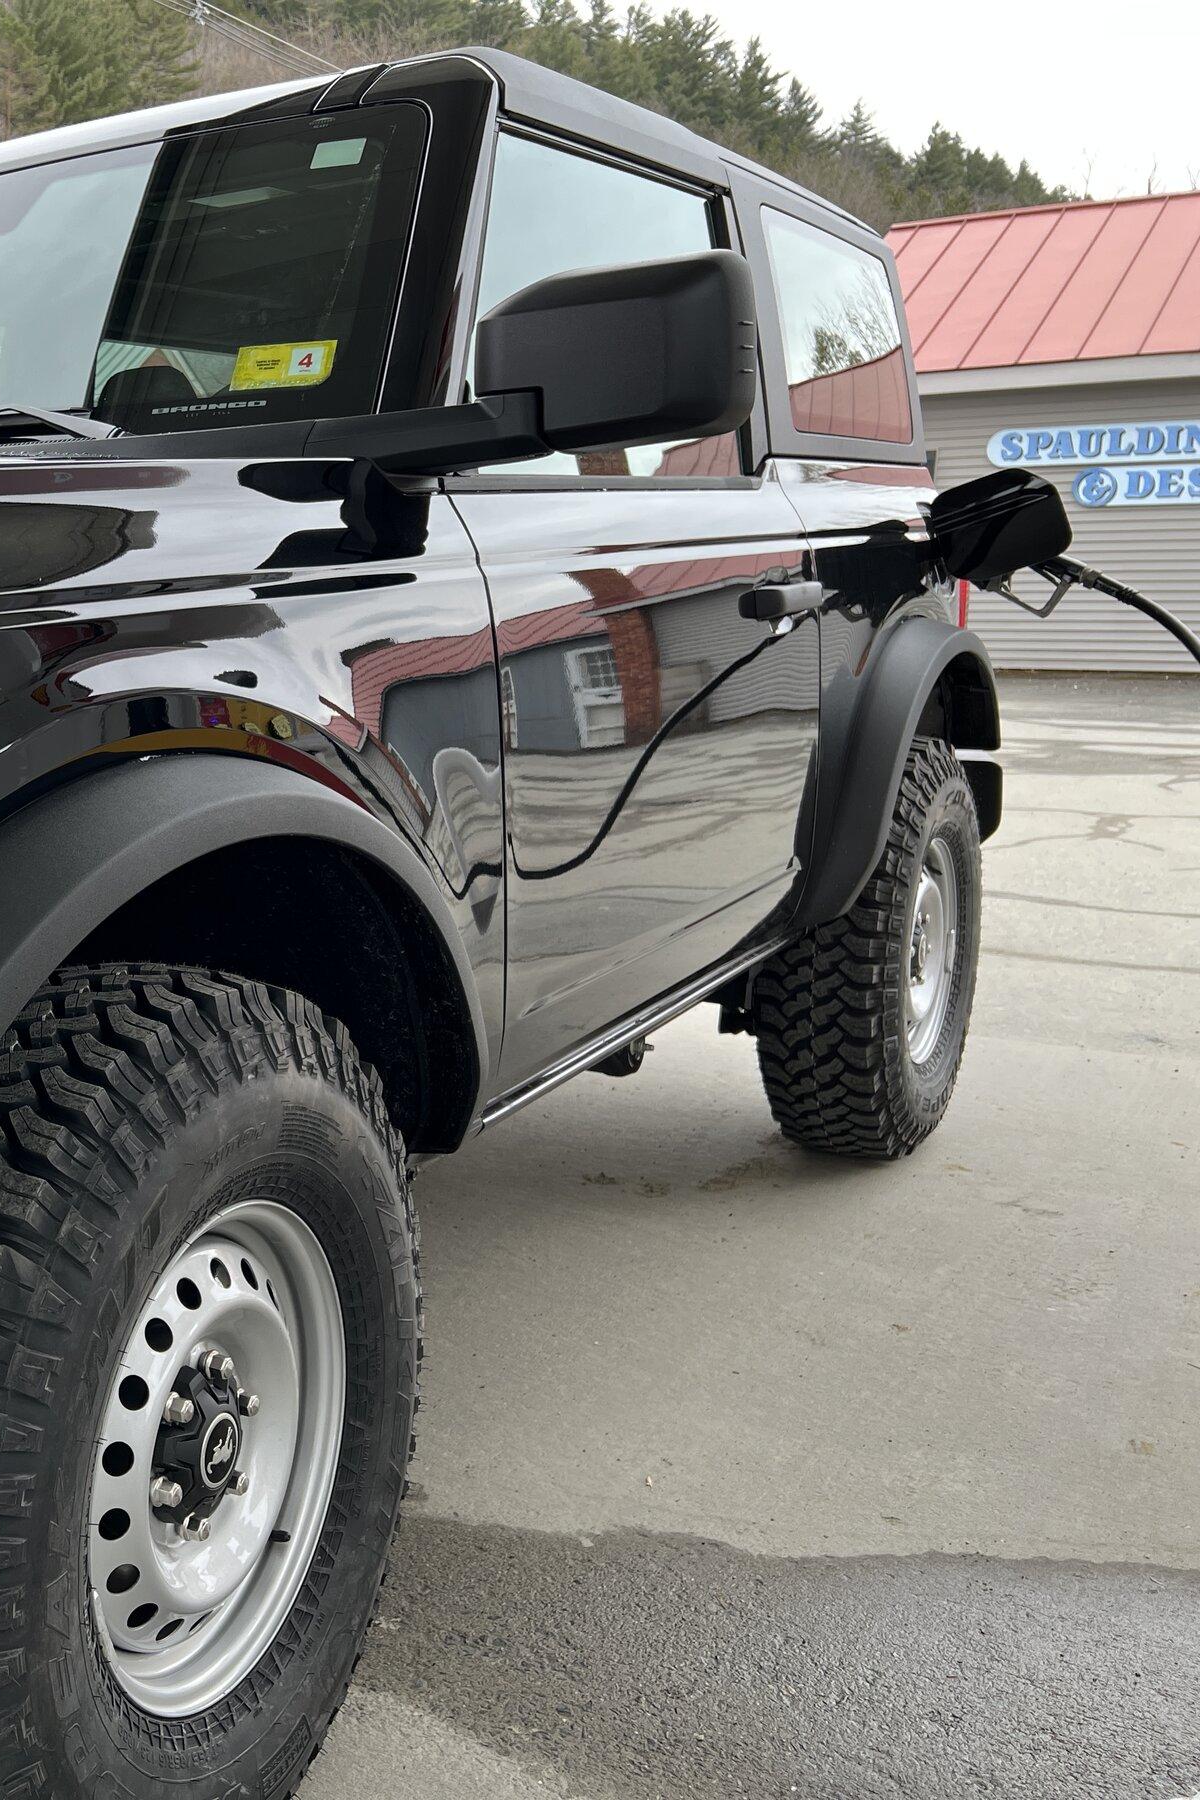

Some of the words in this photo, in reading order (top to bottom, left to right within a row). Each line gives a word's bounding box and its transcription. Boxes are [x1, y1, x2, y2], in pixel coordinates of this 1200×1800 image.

[297, 352, 313, 368] 4
[151, 399, 268, 415] BRONCO
[1001, 424, 1200, 461] SPAULDIN
[1078, 469, 1115, 504] &
